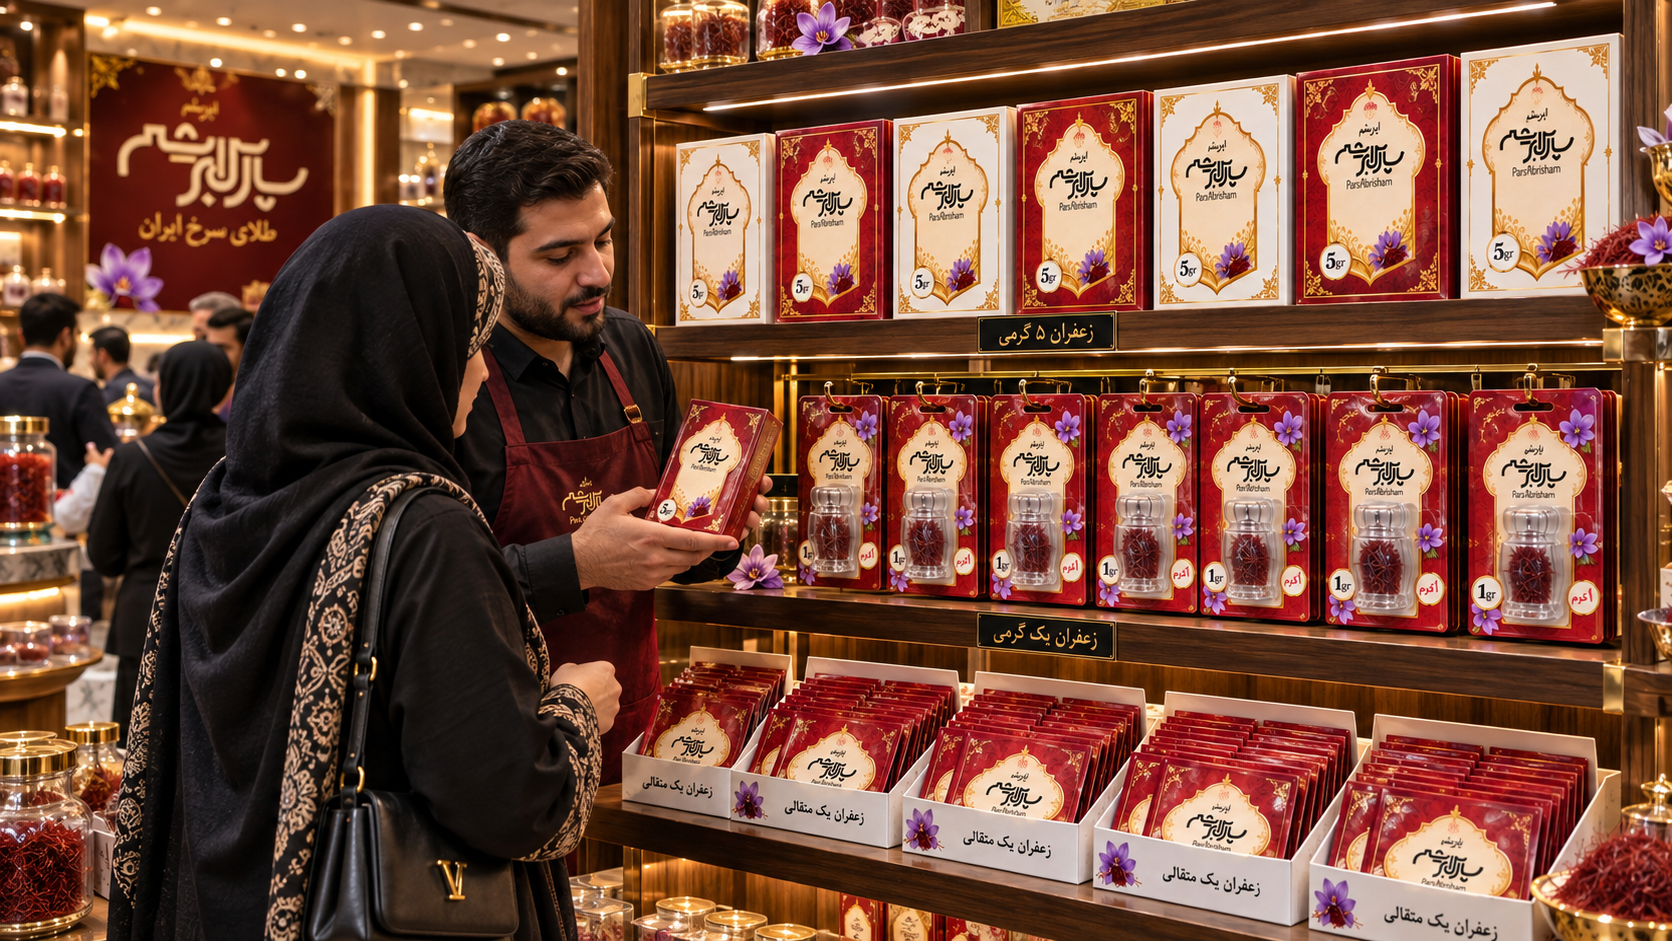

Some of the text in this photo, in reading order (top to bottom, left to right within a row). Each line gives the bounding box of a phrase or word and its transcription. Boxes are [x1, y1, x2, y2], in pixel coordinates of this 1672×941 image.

[138, 211, 278, 247] طلای سرخ ایران
[999, 322, 1094, 346] زعفران ۵ گرمی
[993, 622, 1098, 650] زعفران یک گرمی
[670, 780, 684, 794] یک
[686, 782, 713, 799] زعفران
[815, 805, 831, 820] یک
[834, 808, 864, 825] زعفران
[997, 835, 1014, 852] یک
[1017, 839, 1051, 859] زعفران
[1200, 872, 1219, 890] یک
[1223, 876, 1260, 897] زعفران
[1427, 913, 1450, 933] یک
[1454, 918, 1498, 941] زعفران
